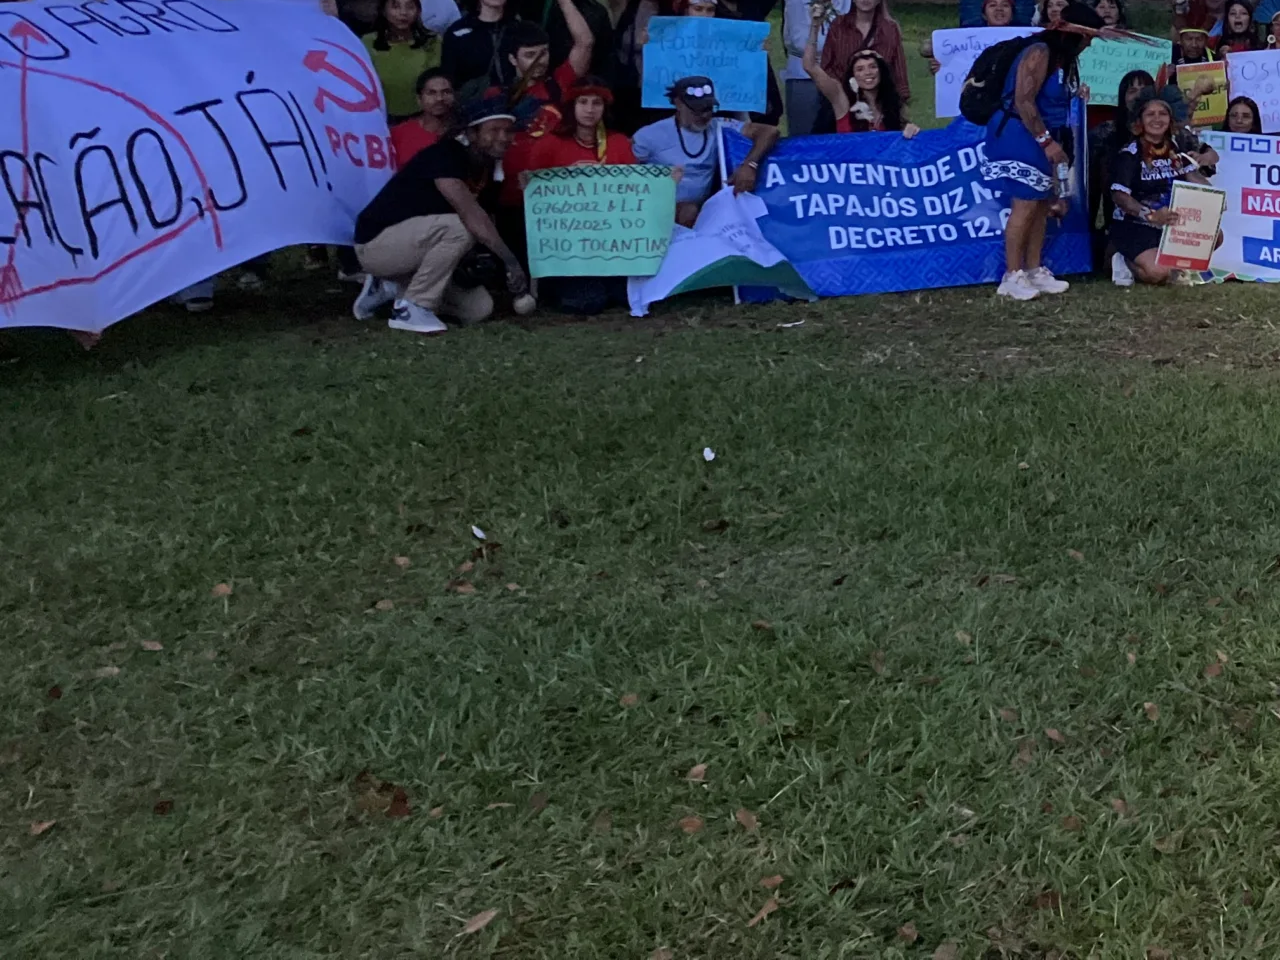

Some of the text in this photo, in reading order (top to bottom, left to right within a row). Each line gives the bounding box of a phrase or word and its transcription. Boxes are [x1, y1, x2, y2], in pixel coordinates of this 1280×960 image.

[44, 0, 239, 45] AGRO
[0, 70, 332, 268] AÇÃO, JÁ!
[765, 164, 785, 188] A
[792, 154, 955, 188] JUVENTUDE
[529, 182, 651, 198] ANULA LICENÇA
[789, 192, 918, 219] TAPAJÓS
[923, 189, 969, 216] DIZ
[532, 200, 604, 215] 676/2022
[620, 218, 646, 229] DO
[828, 207, 1013, 250] DECRETO 12.6
[539, 238, 669, 255] RIO TOCANTINS
